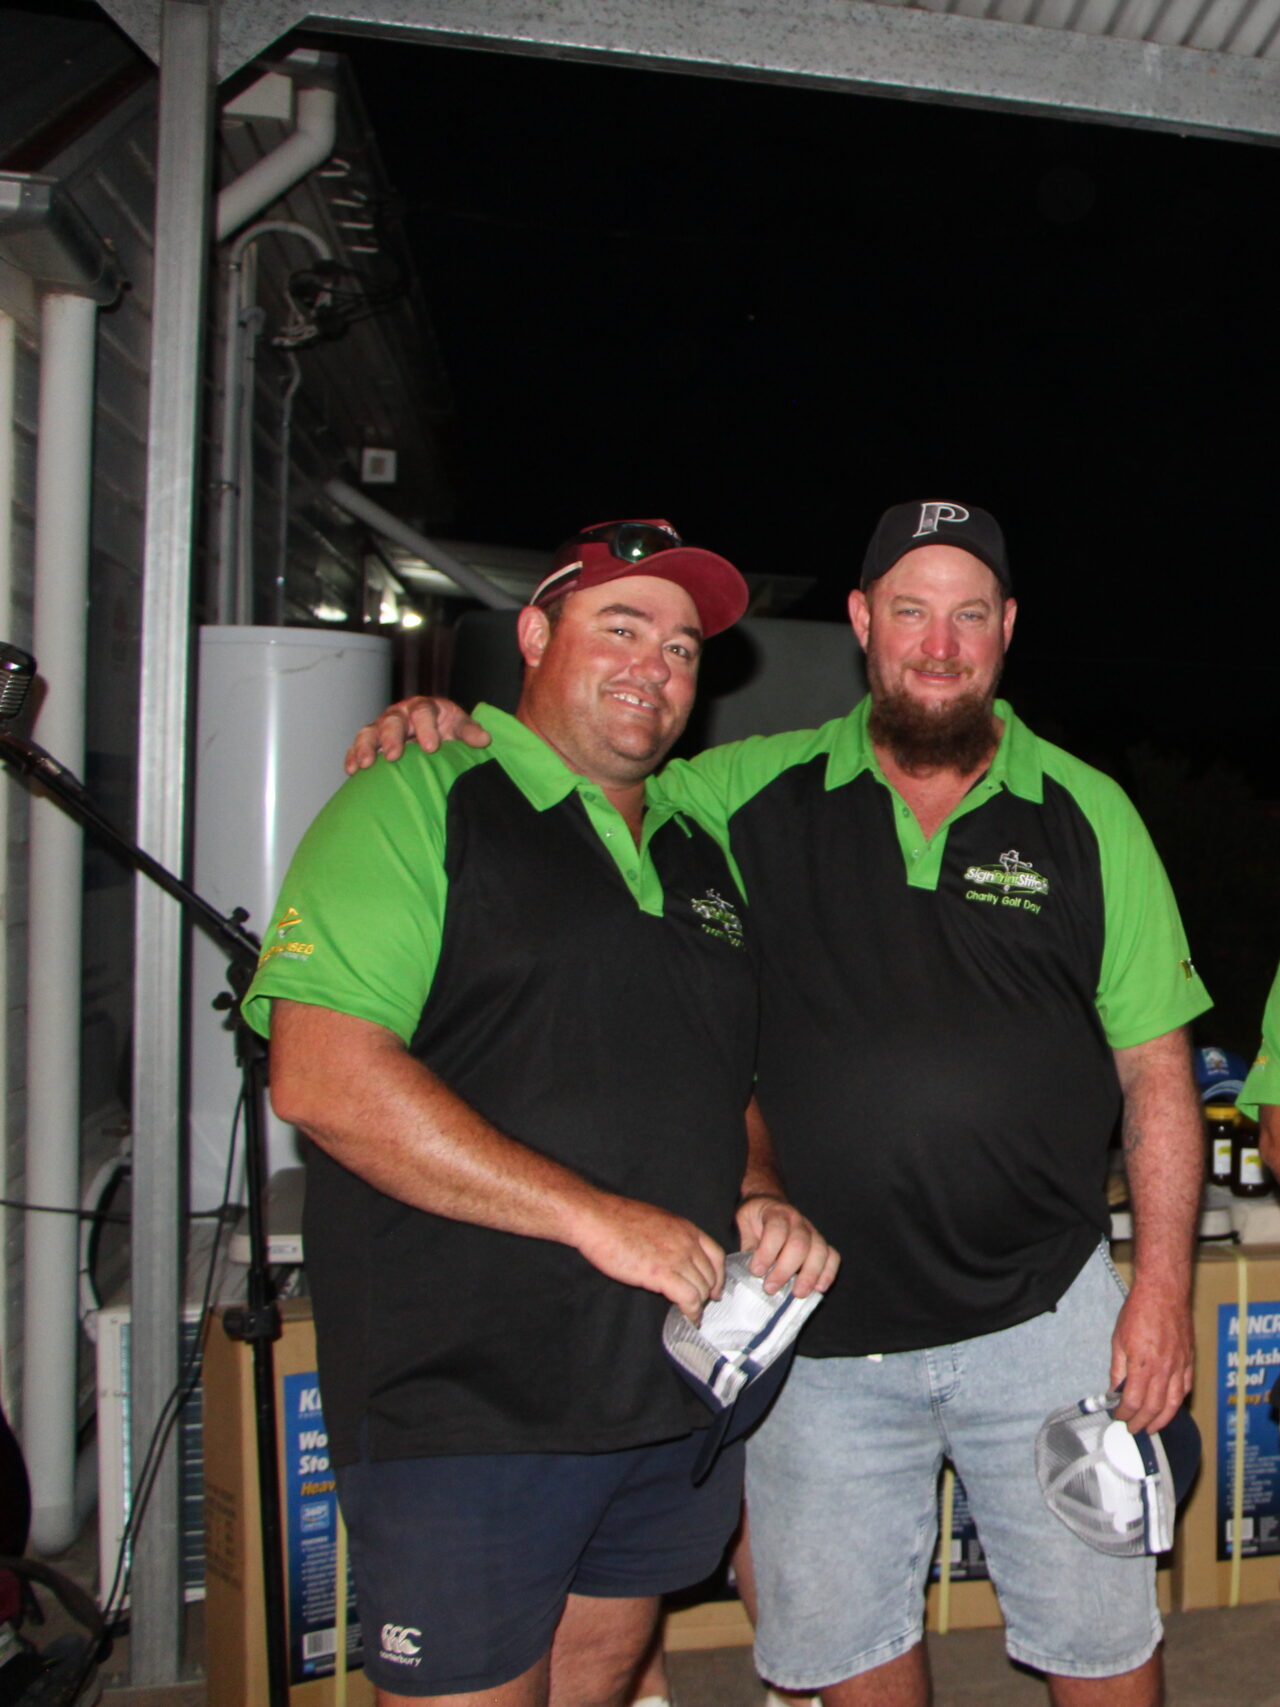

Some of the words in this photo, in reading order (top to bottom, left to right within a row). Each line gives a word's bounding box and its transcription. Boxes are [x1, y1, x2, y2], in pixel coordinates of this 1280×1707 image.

[912, 501, 970, 538] P
[965, 889, 998, 906] Charity
[1001, 896, 1022, 908] Golf
[1023, 899, 1042, 915] Day
